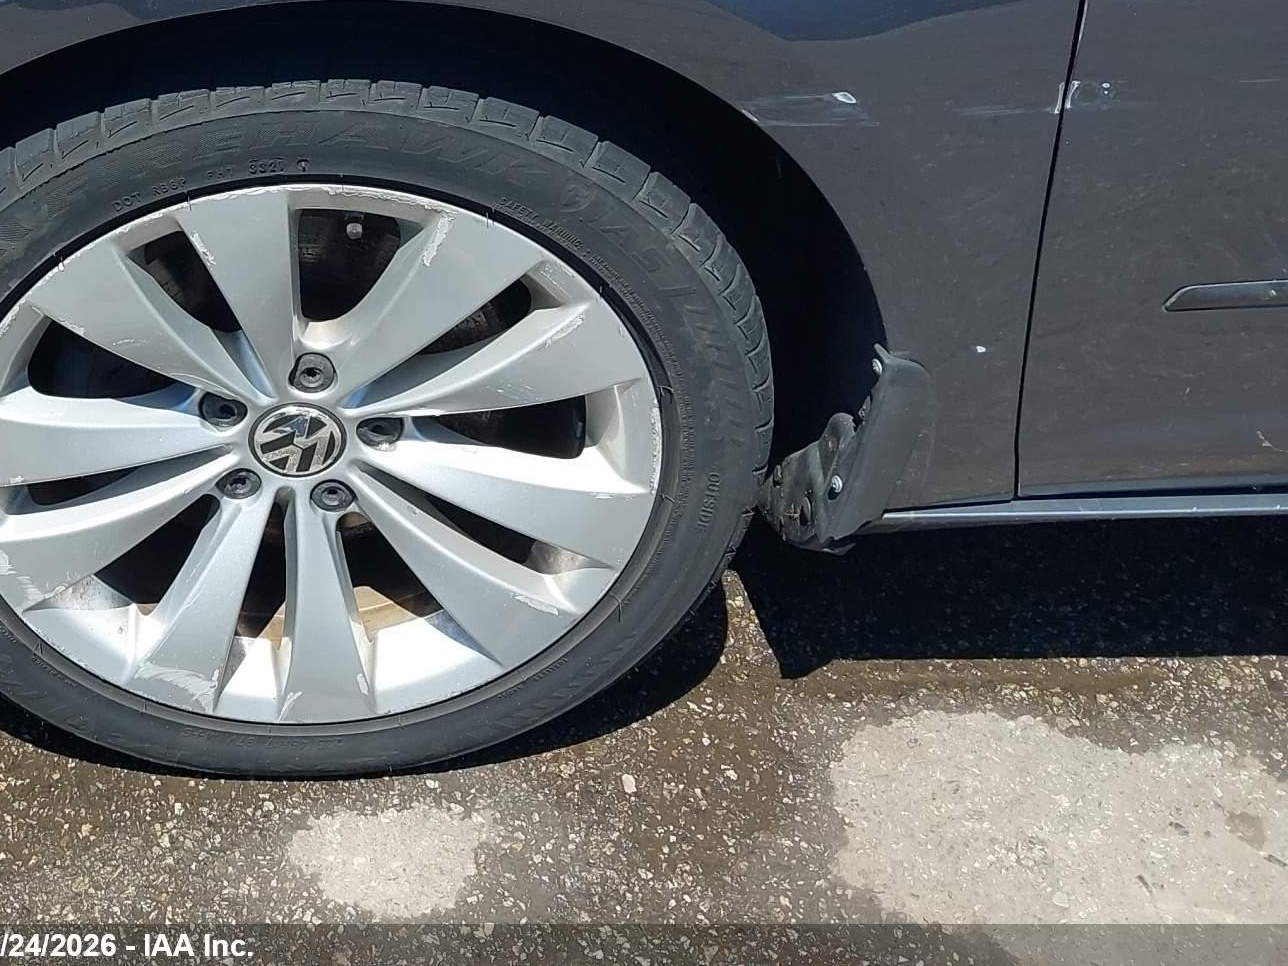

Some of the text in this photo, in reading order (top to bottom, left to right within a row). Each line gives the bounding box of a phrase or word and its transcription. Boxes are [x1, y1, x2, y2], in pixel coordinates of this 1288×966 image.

[113, 192, 140, 212] DOT
[498, 196, 538, 221] SAFETY
[697, 472, 722, 530] OUTSIDE
